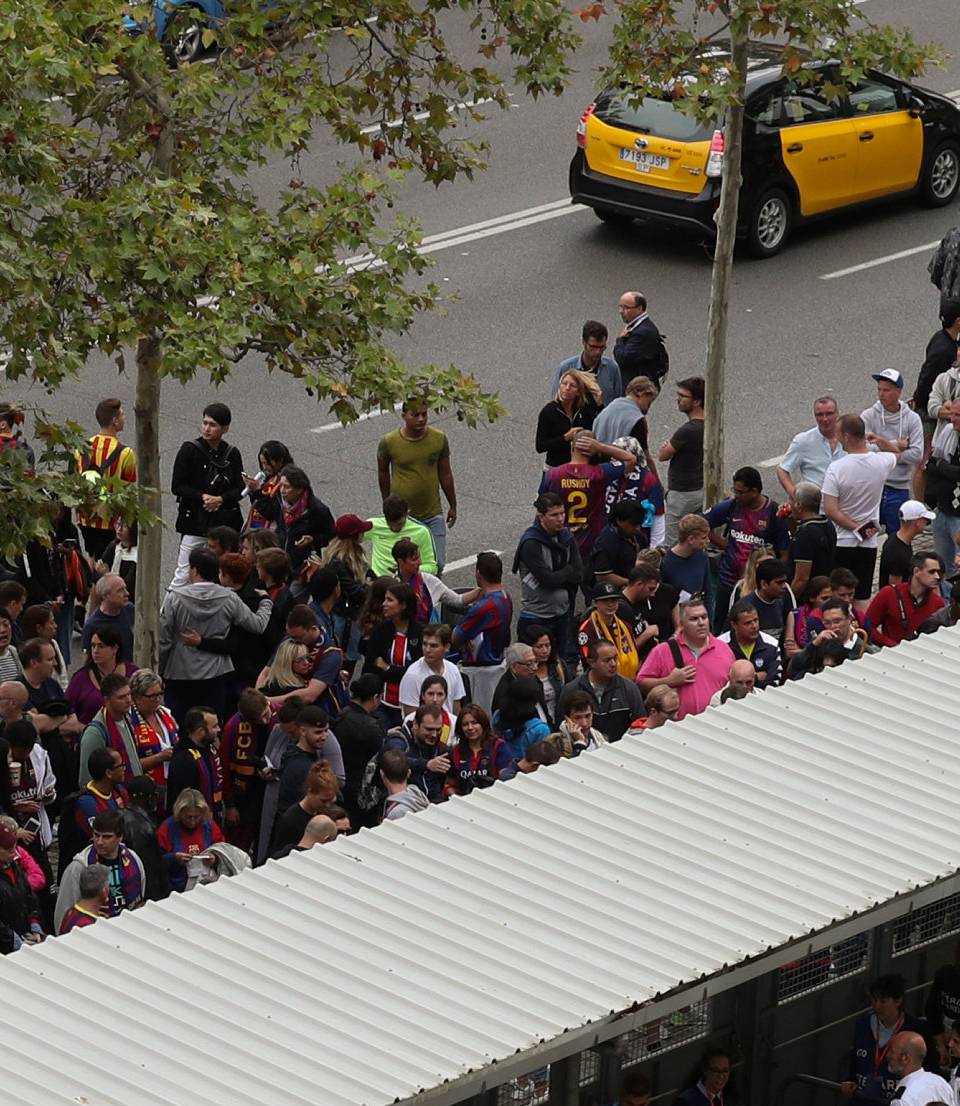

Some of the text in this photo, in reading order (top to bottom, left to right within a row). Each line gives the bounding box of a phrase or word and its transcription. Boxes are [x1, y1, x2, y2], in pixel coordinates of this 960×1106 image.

[624, 149, 646, 163] 7193
[648, 153, 666, 167] JSP
[567, 490, 588, 523] 2
[236, 721, 253, 760] FCB
